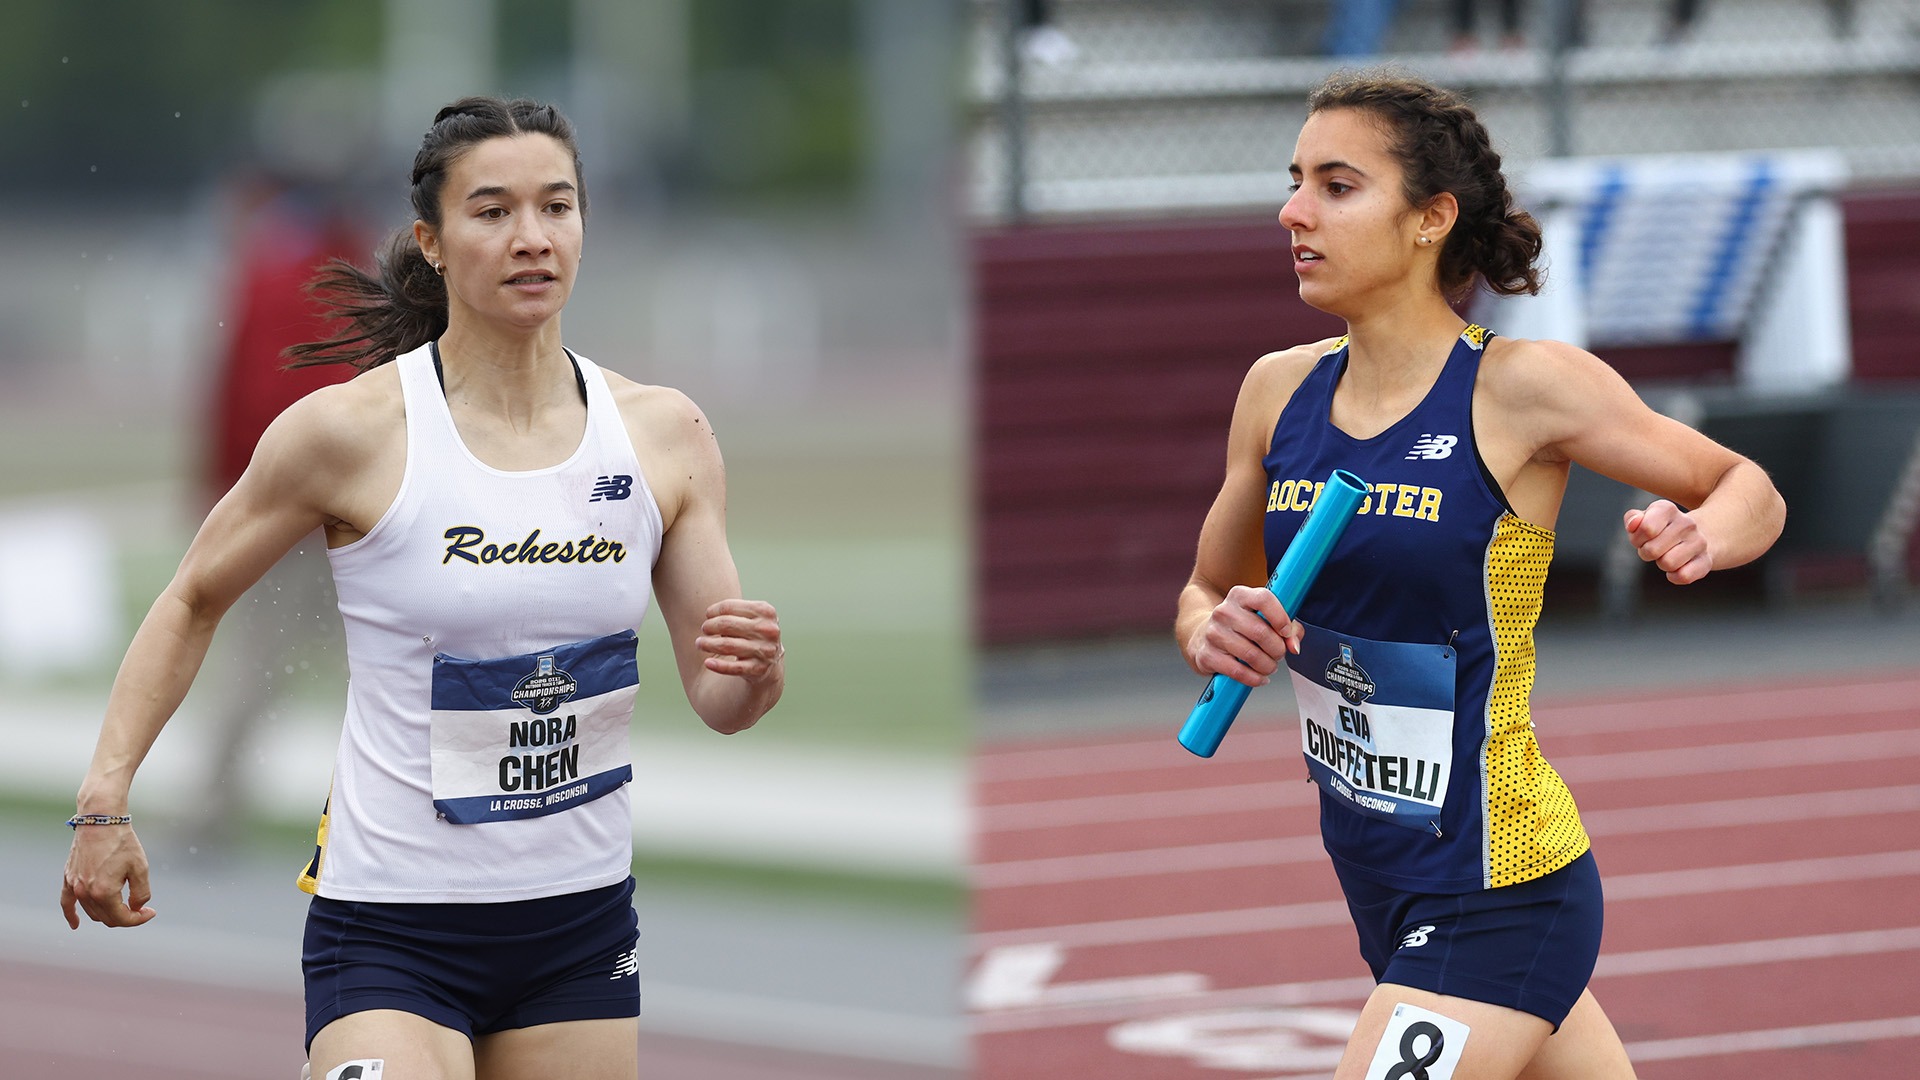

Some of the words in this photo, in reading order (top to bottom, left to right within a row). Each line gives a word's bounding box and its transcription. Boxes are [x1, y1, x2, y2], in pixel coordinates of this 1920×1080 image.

[1404, 433, 1458, 460] NB
[589, 474, 633, 502] NB
[1266, 479, 1443, 522] ROCSTER
[442, 526, 627, 565] Rochester
[513, 683, 575, 699] CHAMPIONSHIPS
[1326, 671, 1374, 693] CHAMPIONSHIPS
[509, 714, 577, 747] NORA
[1338, 705, 1371, 743] EVA
[499, 743, 580, 792] CHEN
[1306, 717, 1441, 802] CIUFFETELLI
[490, 800, 501, 811] LA
[503, 798, 543, 810] CROSSE,
[546, 783, 588, 806] WISCONSIN
[1354, 792, 1397, 814] WISCONSIN
